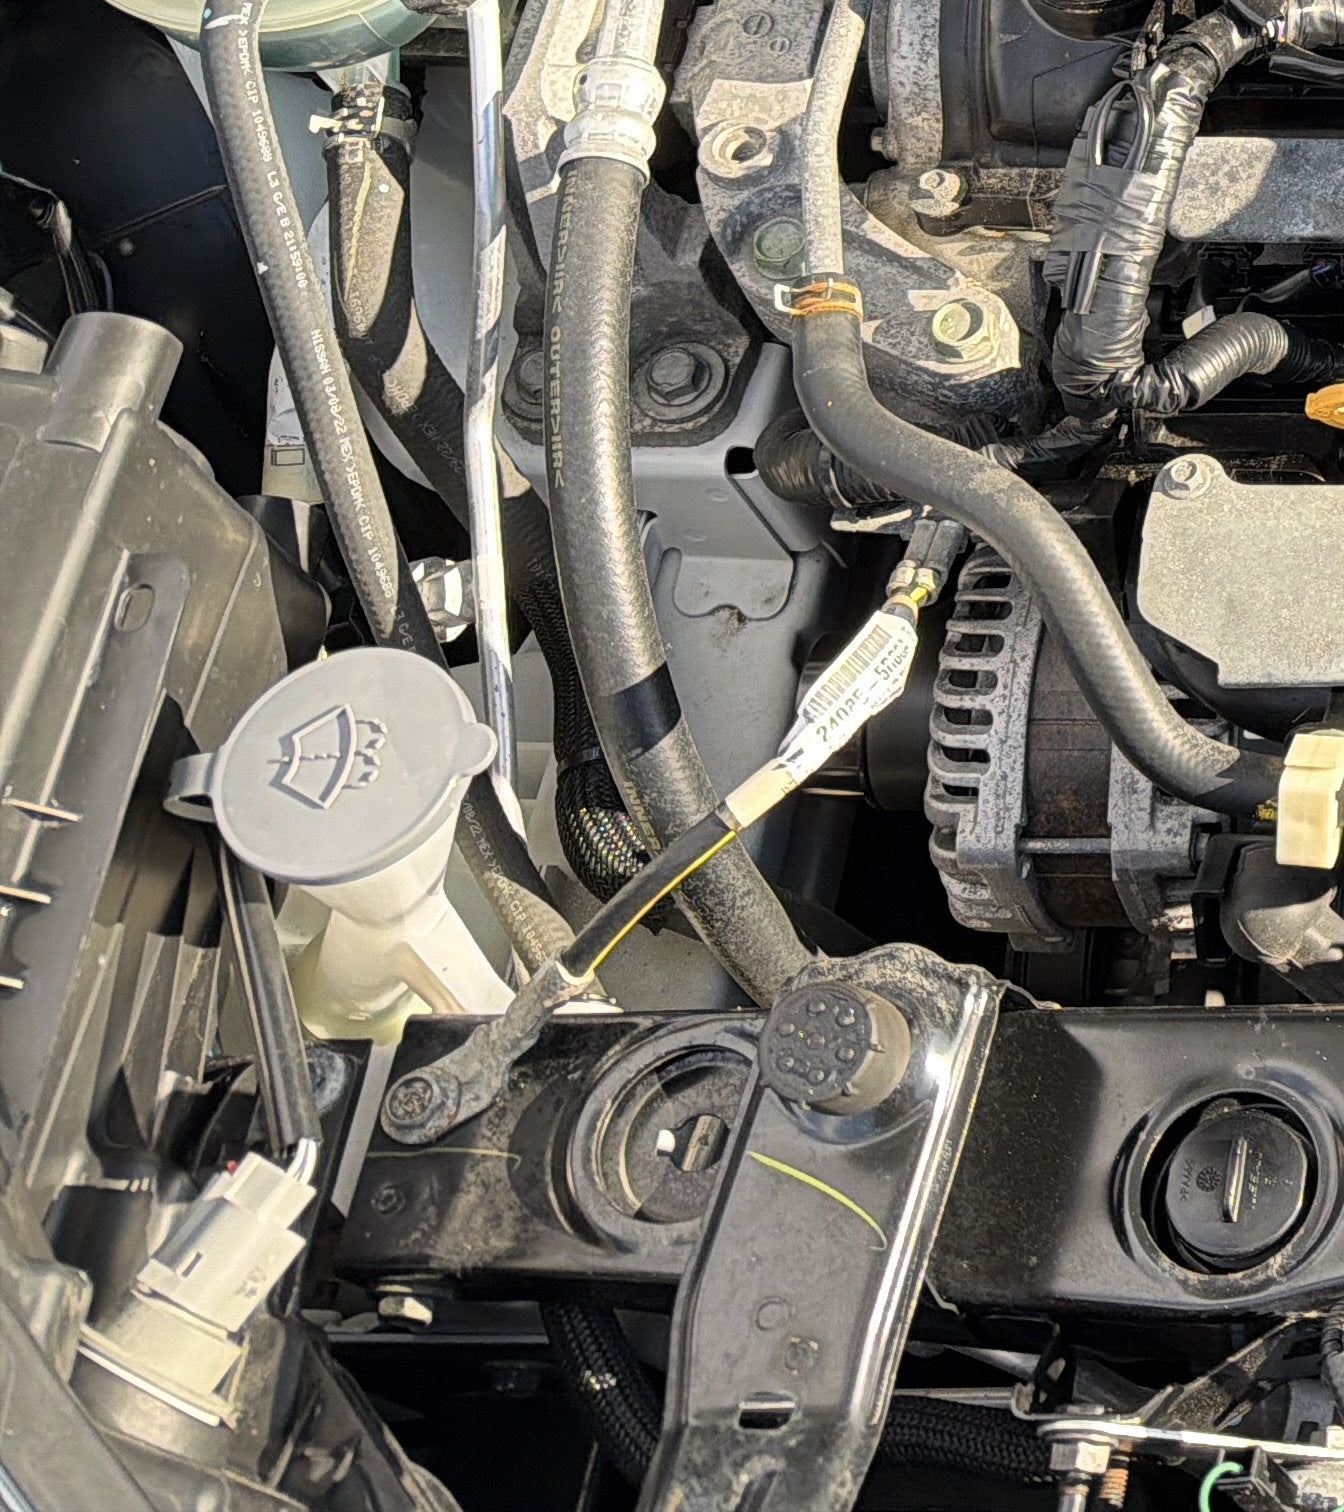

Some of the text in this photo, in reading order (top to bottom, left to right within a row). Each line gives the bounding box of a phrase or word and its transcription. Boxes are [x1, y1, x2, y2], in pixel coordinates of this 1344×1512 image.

[245, 79, 259, 104] CIP
[310, 328, 333, 377] NISSAN
[358, 513, 374, 542] CIP
